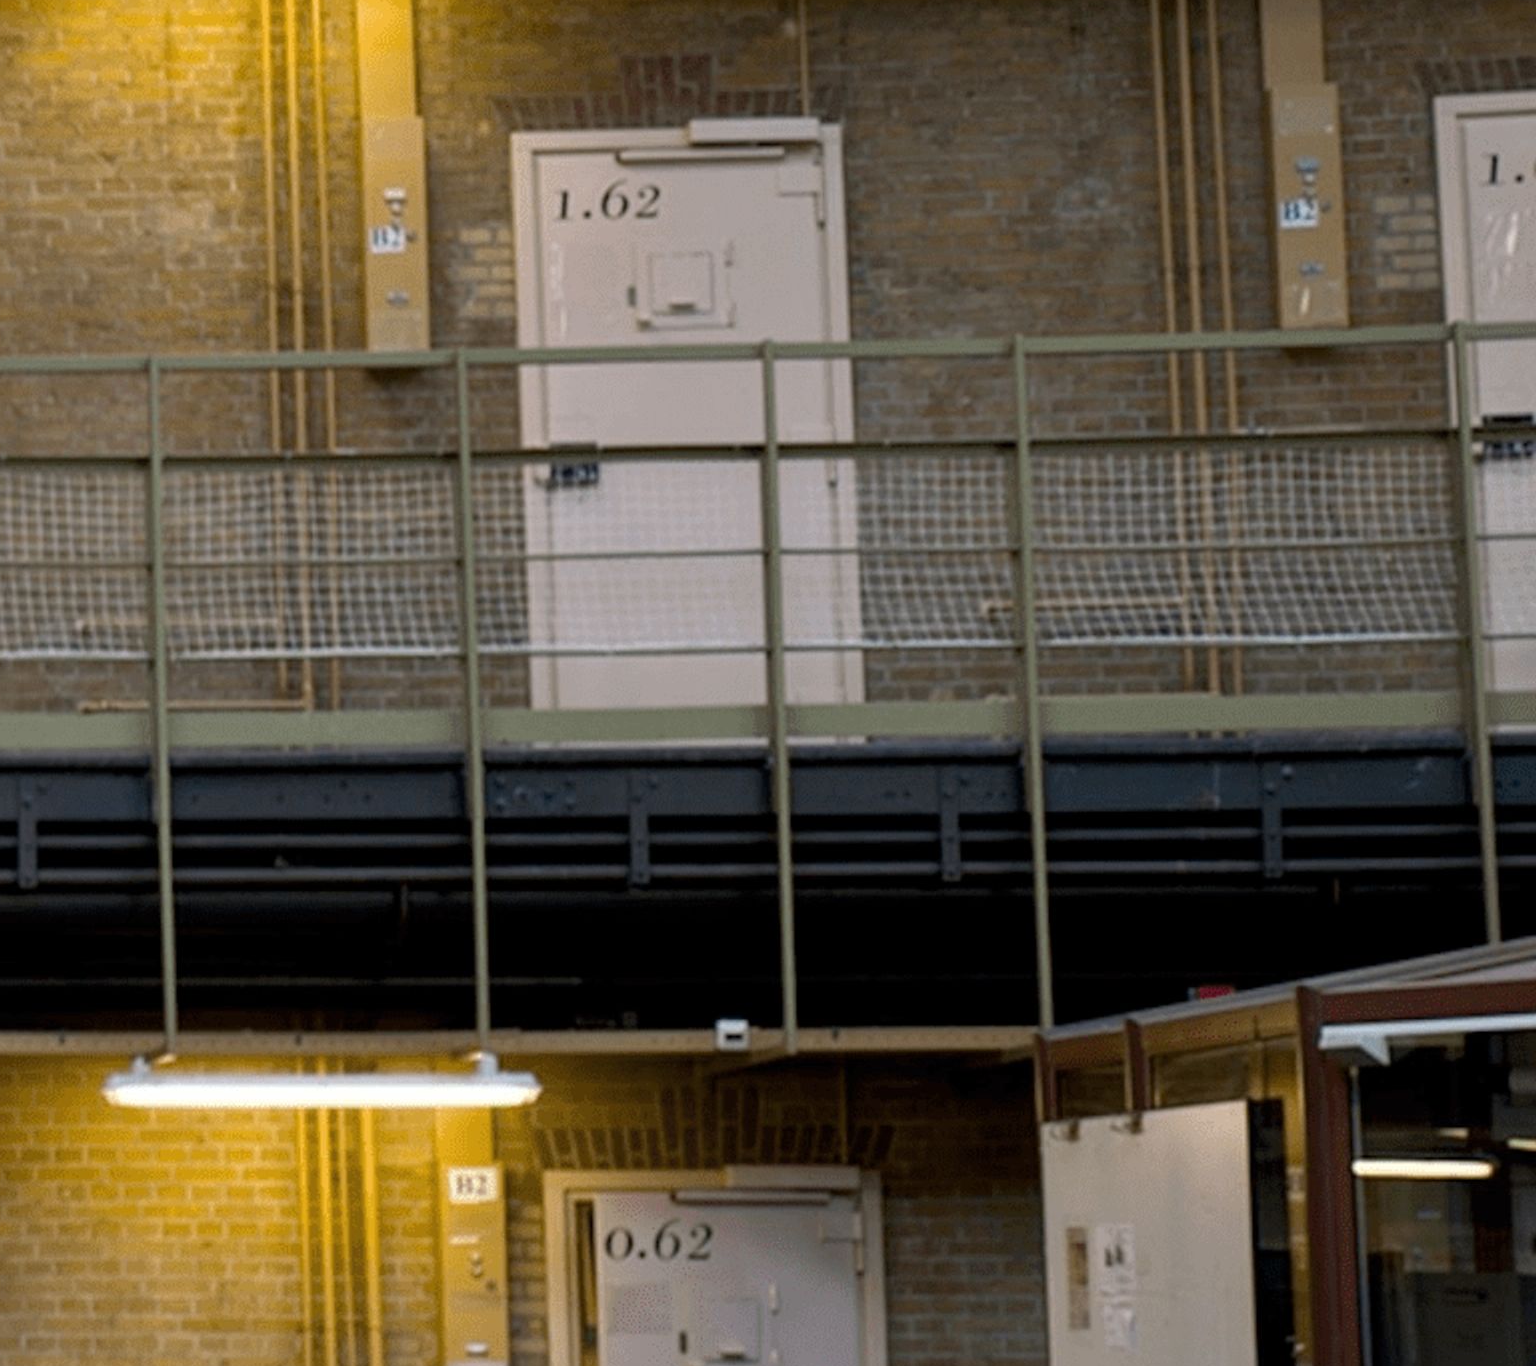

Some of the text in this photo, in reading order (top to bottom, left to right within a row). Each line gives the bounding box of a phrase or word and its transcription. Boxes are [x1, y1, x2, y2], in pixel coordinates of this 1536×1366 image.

[1480, 151, 1536, 187] 1.
[555, 178, 662, 221] 1.62
[604, 1217, 713, 1262] 0.62
